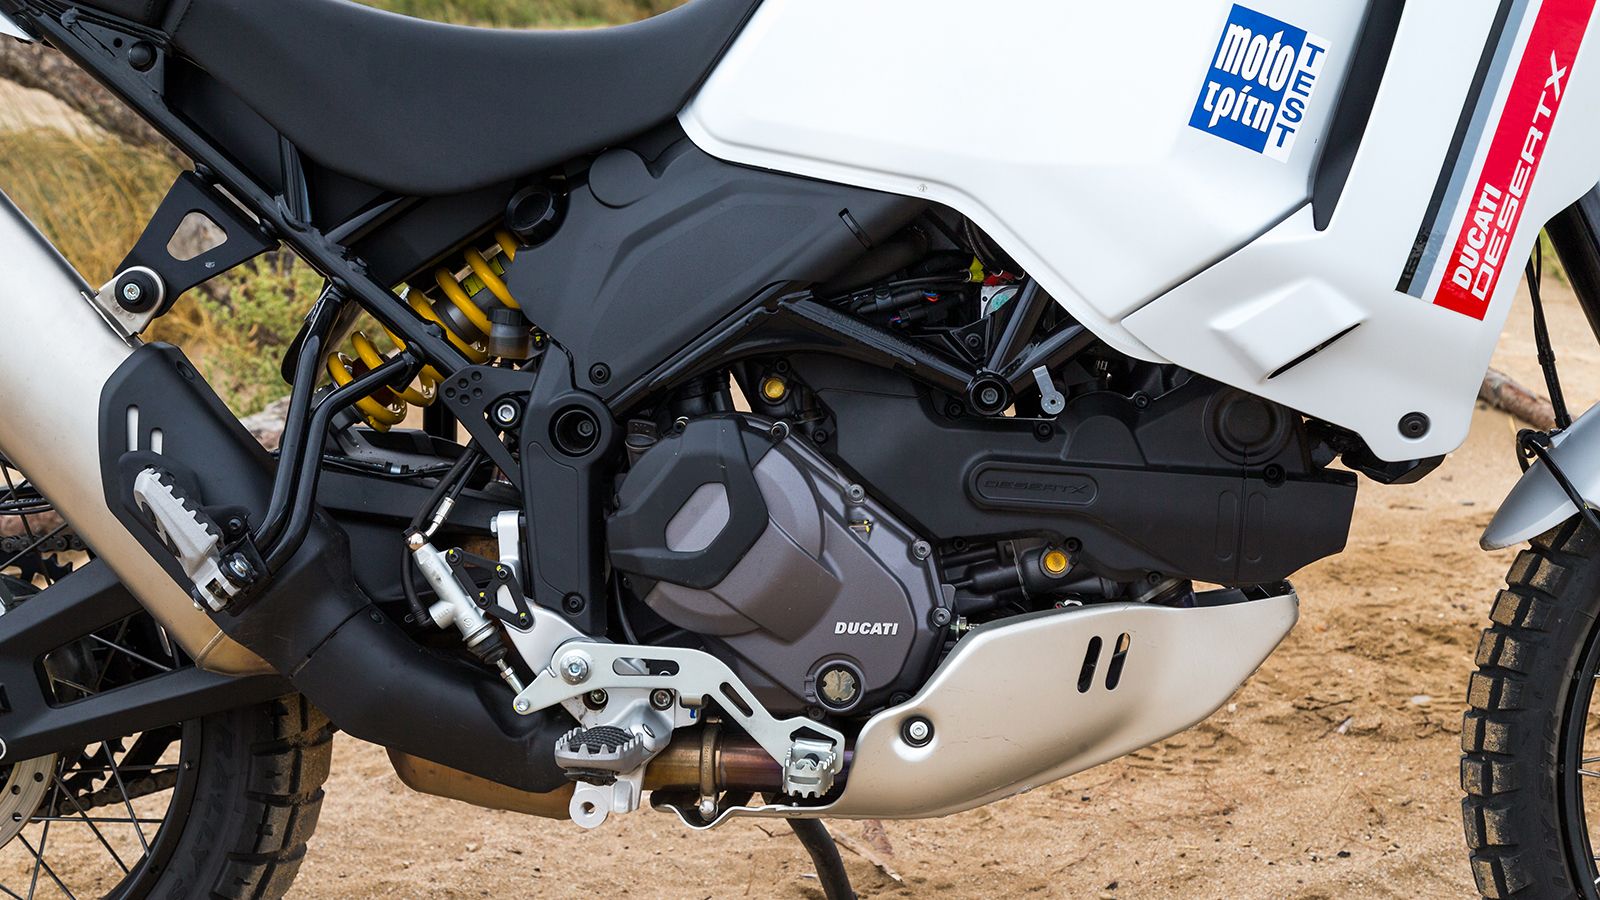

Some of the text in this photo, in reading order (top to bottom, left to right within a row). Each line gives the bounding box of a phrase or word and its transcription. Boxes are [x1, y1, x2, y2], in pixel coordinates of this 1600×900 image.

[1214, 23, 1295, 92] moto
[1276, 42, 1326, 148] TEST
[1203, 81, 1275, 133] τρίτη
[1471, 49, 1568, 302] DESERTX
[1452, 182, 1502, 290] DUCATI
[834, 621, 899, 635] DUCATI
